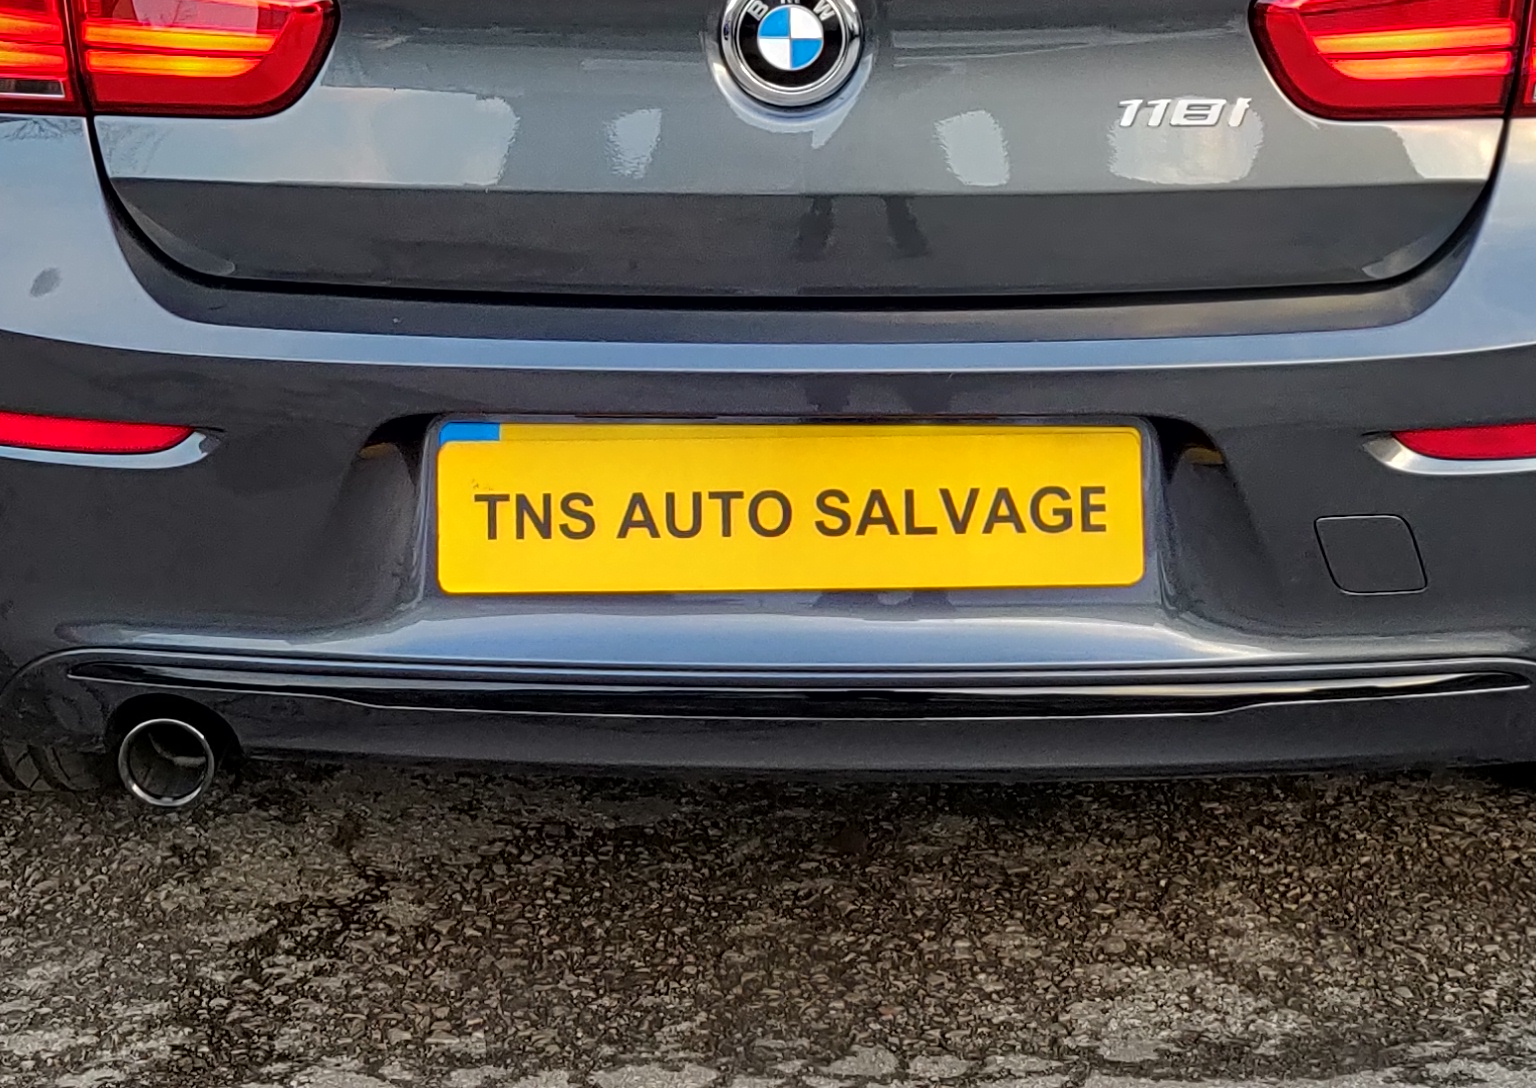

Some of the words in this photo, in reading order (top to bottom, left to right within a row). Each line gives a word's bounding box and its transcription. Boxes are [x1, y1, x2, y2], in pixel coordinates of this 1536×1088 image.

[474, 492, 596, 541] TNS
[617, 489, 793, 539] AUTO
[814, 485, 1107, 536] SALVAGE
